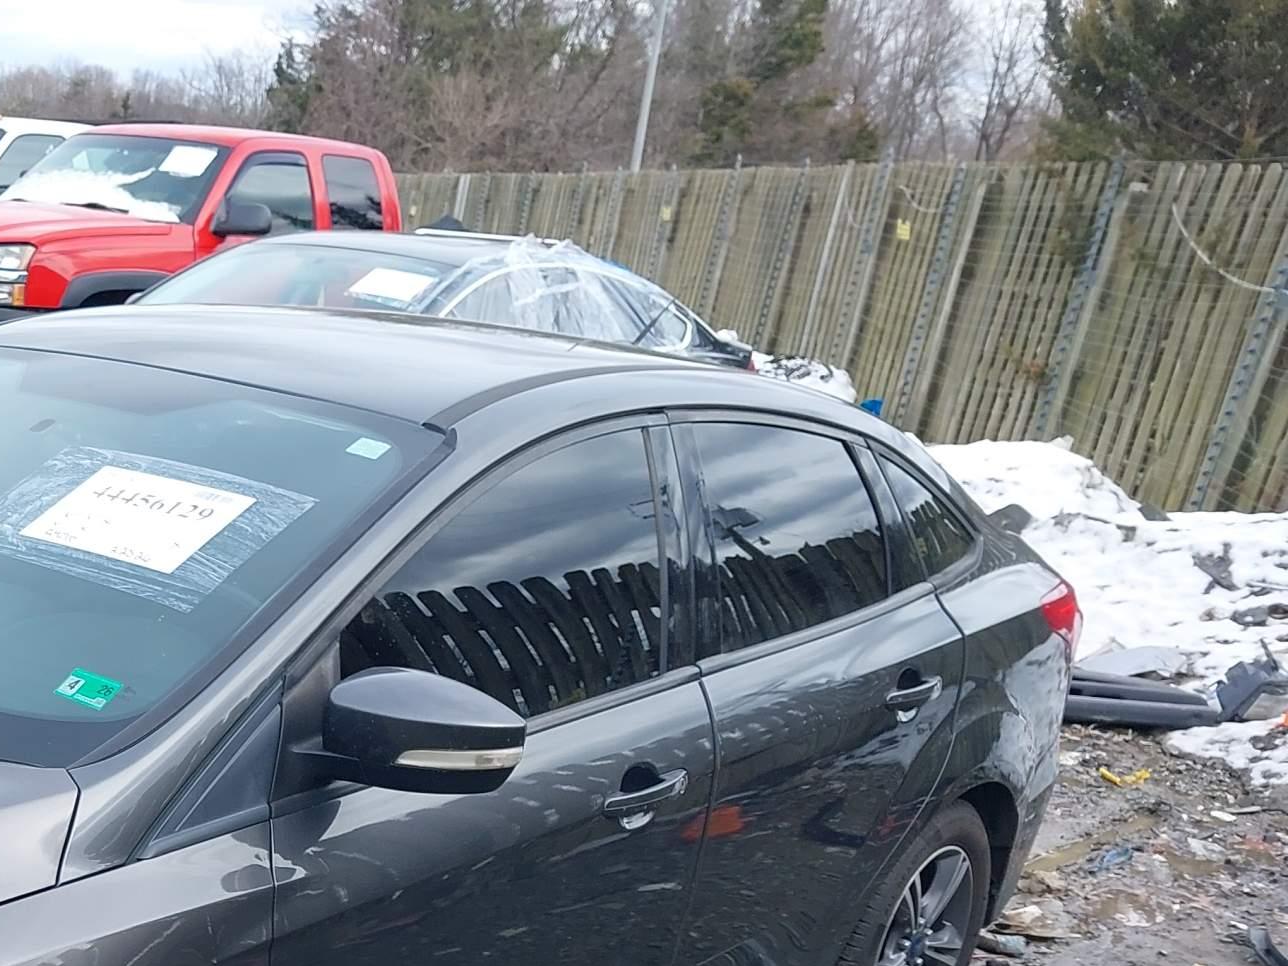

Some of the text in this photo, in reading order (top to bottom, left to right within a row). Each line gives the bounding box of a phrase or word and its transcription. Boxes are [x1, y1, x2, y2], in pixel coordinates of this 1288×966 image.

[92, 485, 215, 521] 44456129
[67, 679, 81, 690] 4
[96, 684, 114, 697] 26
